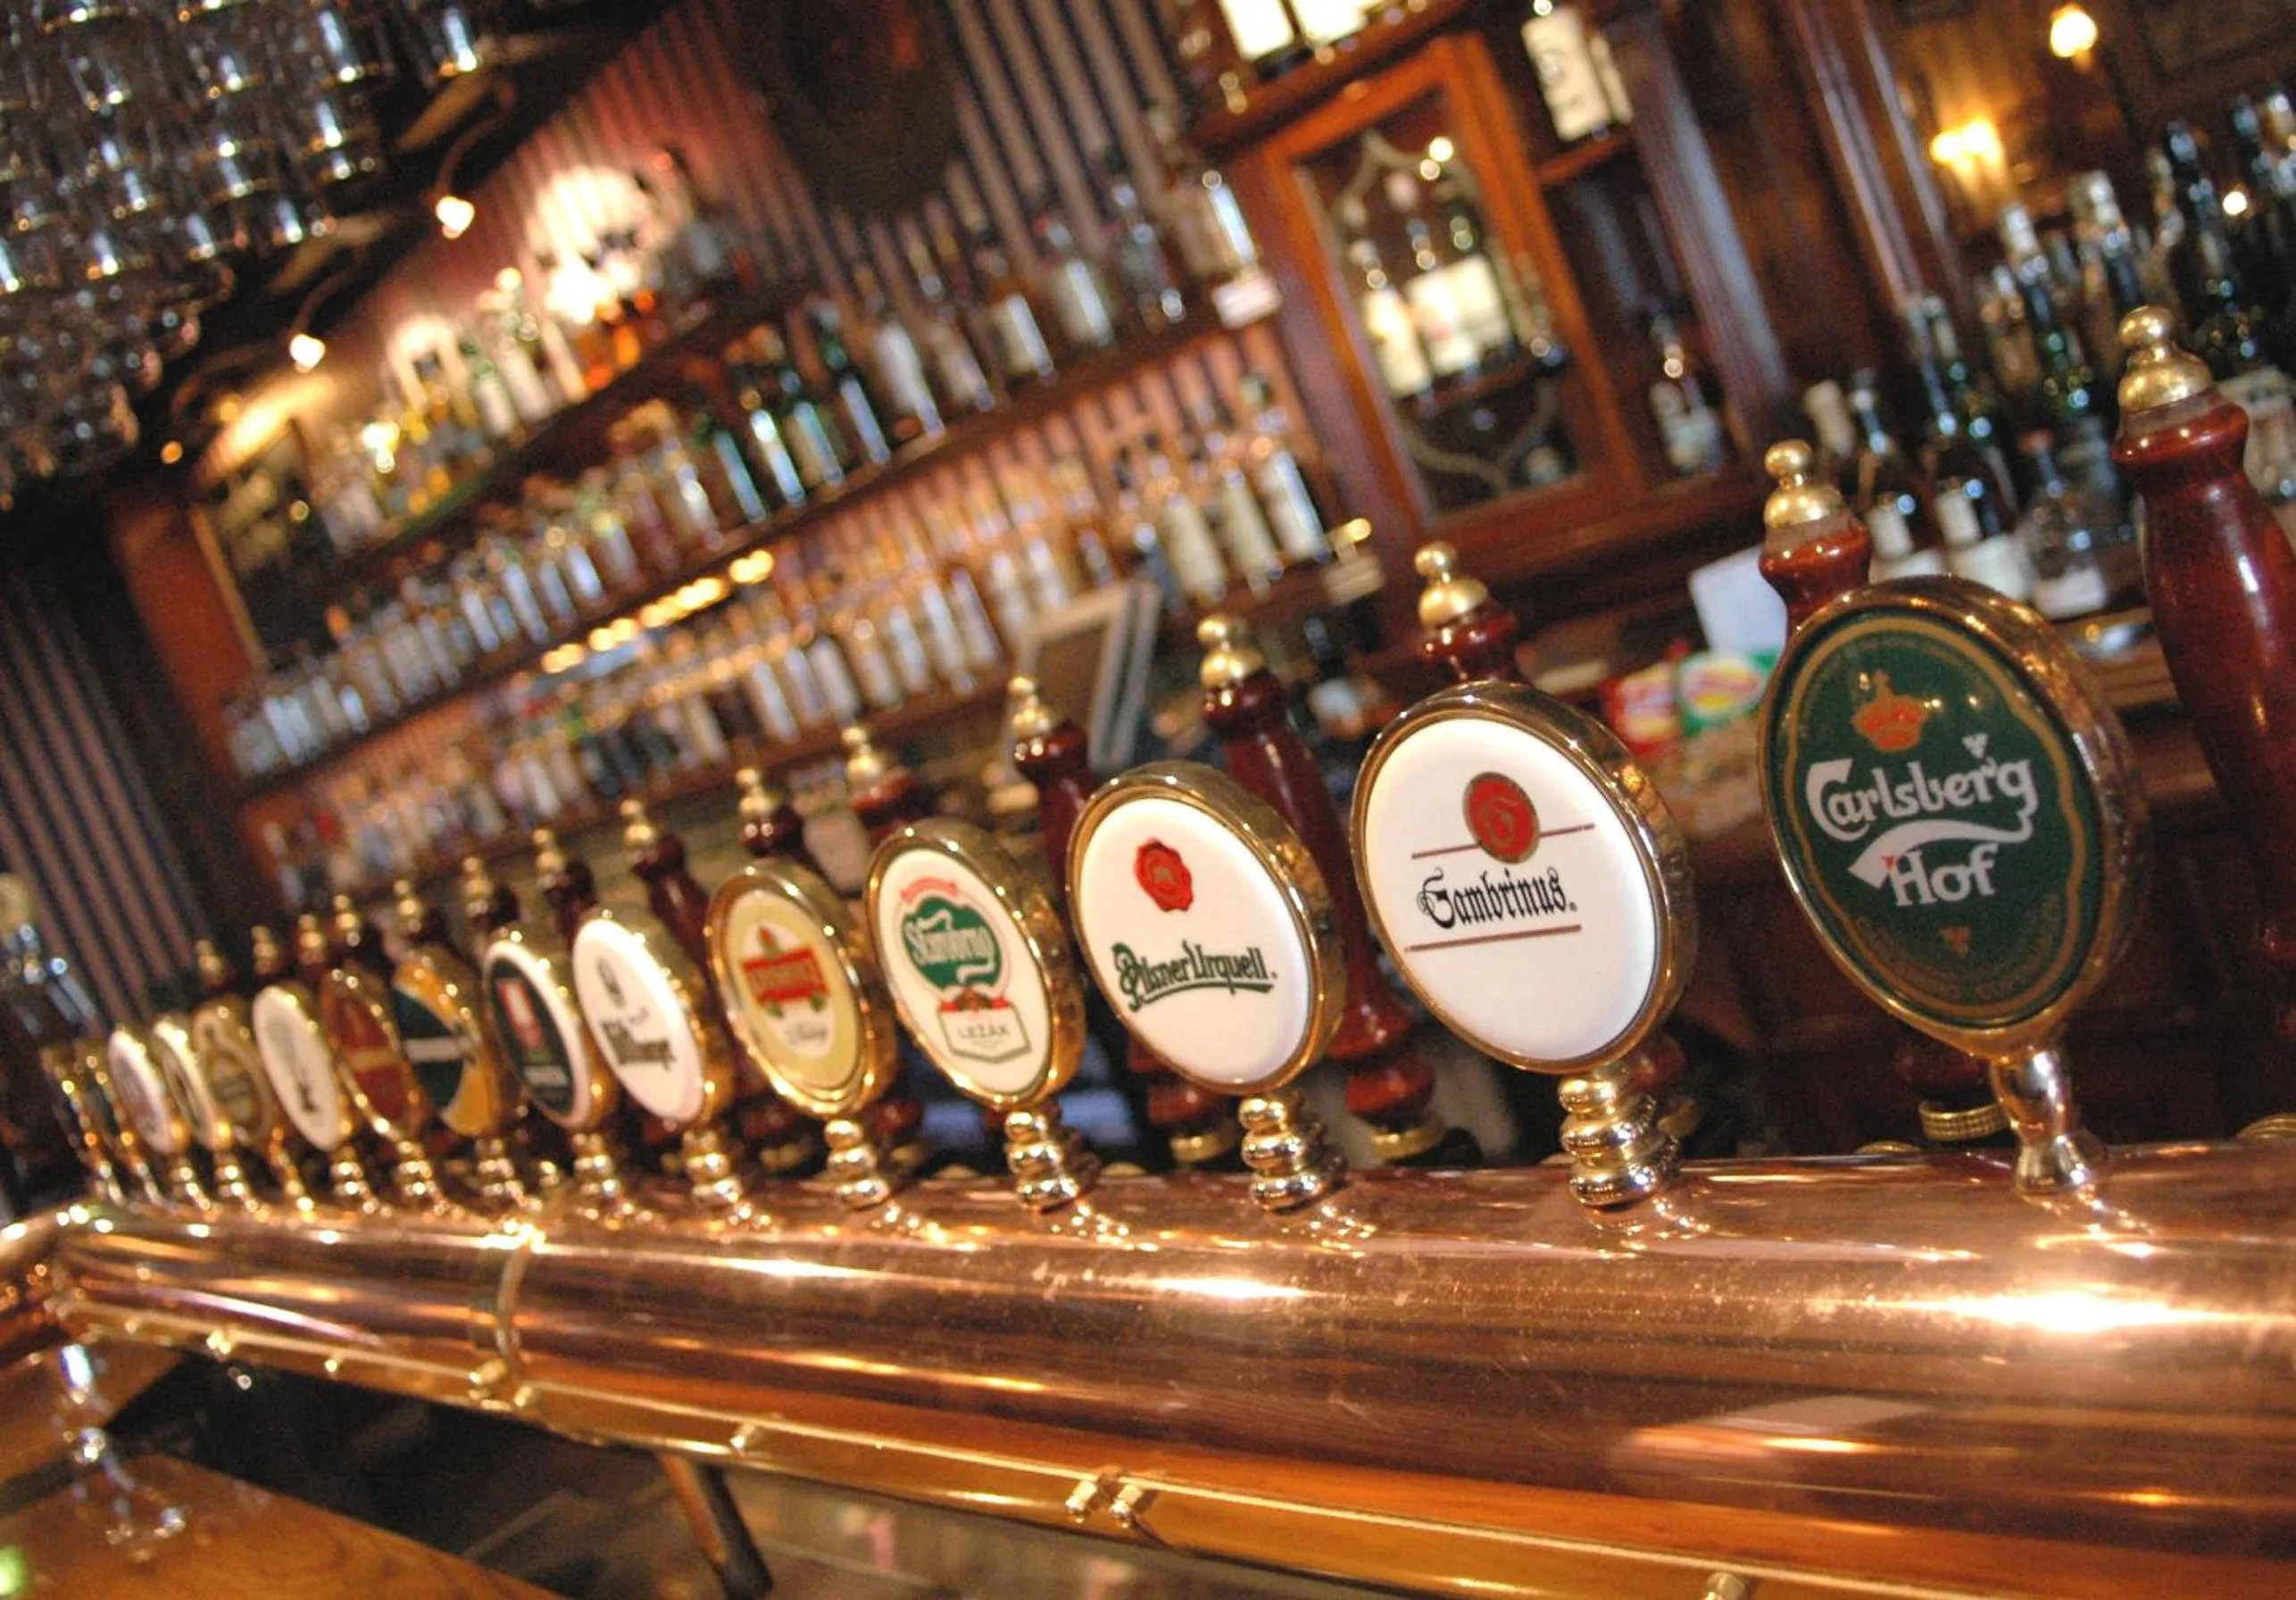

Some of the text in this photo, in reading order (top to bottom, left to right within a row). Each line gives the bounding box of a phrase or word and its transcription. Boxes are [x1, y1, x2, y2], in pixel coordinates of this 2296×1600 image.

[1805, 757, 2041, 843] Carlsberg
[1417, 866, 1568, 929] Gambrinus
[1891, 844, 1999, 907] Hof
[1111, 939, 1269, 1012] Pilsner Urquell
